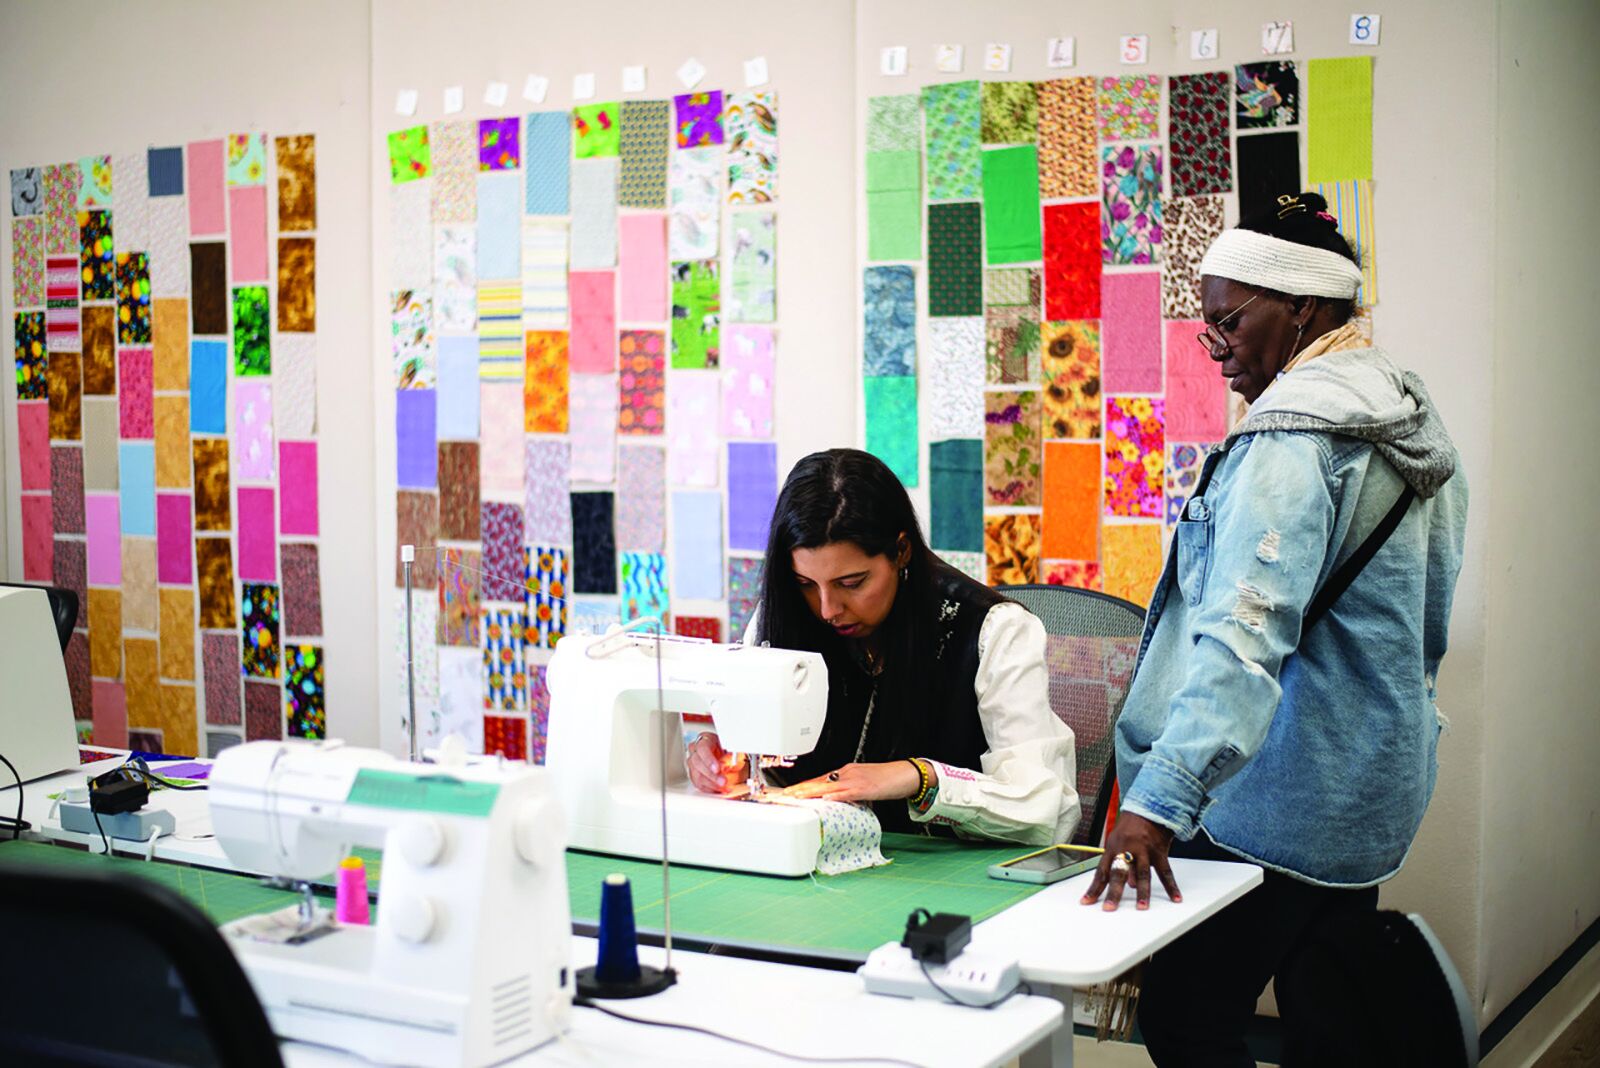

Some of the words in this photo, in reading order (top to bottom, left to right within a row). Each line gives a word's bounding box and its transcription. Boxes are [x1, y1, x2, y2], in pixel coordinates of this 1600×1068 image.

[1269, 23, 1286, 54] 7
[1356, 17, 1371, 40] 8
[1124, 37, 1141, 61] 5
[1198, 32, 1210, 57] 6
[938, 47, 954, 70] 2
[991, 46, 1004, 69] 3
